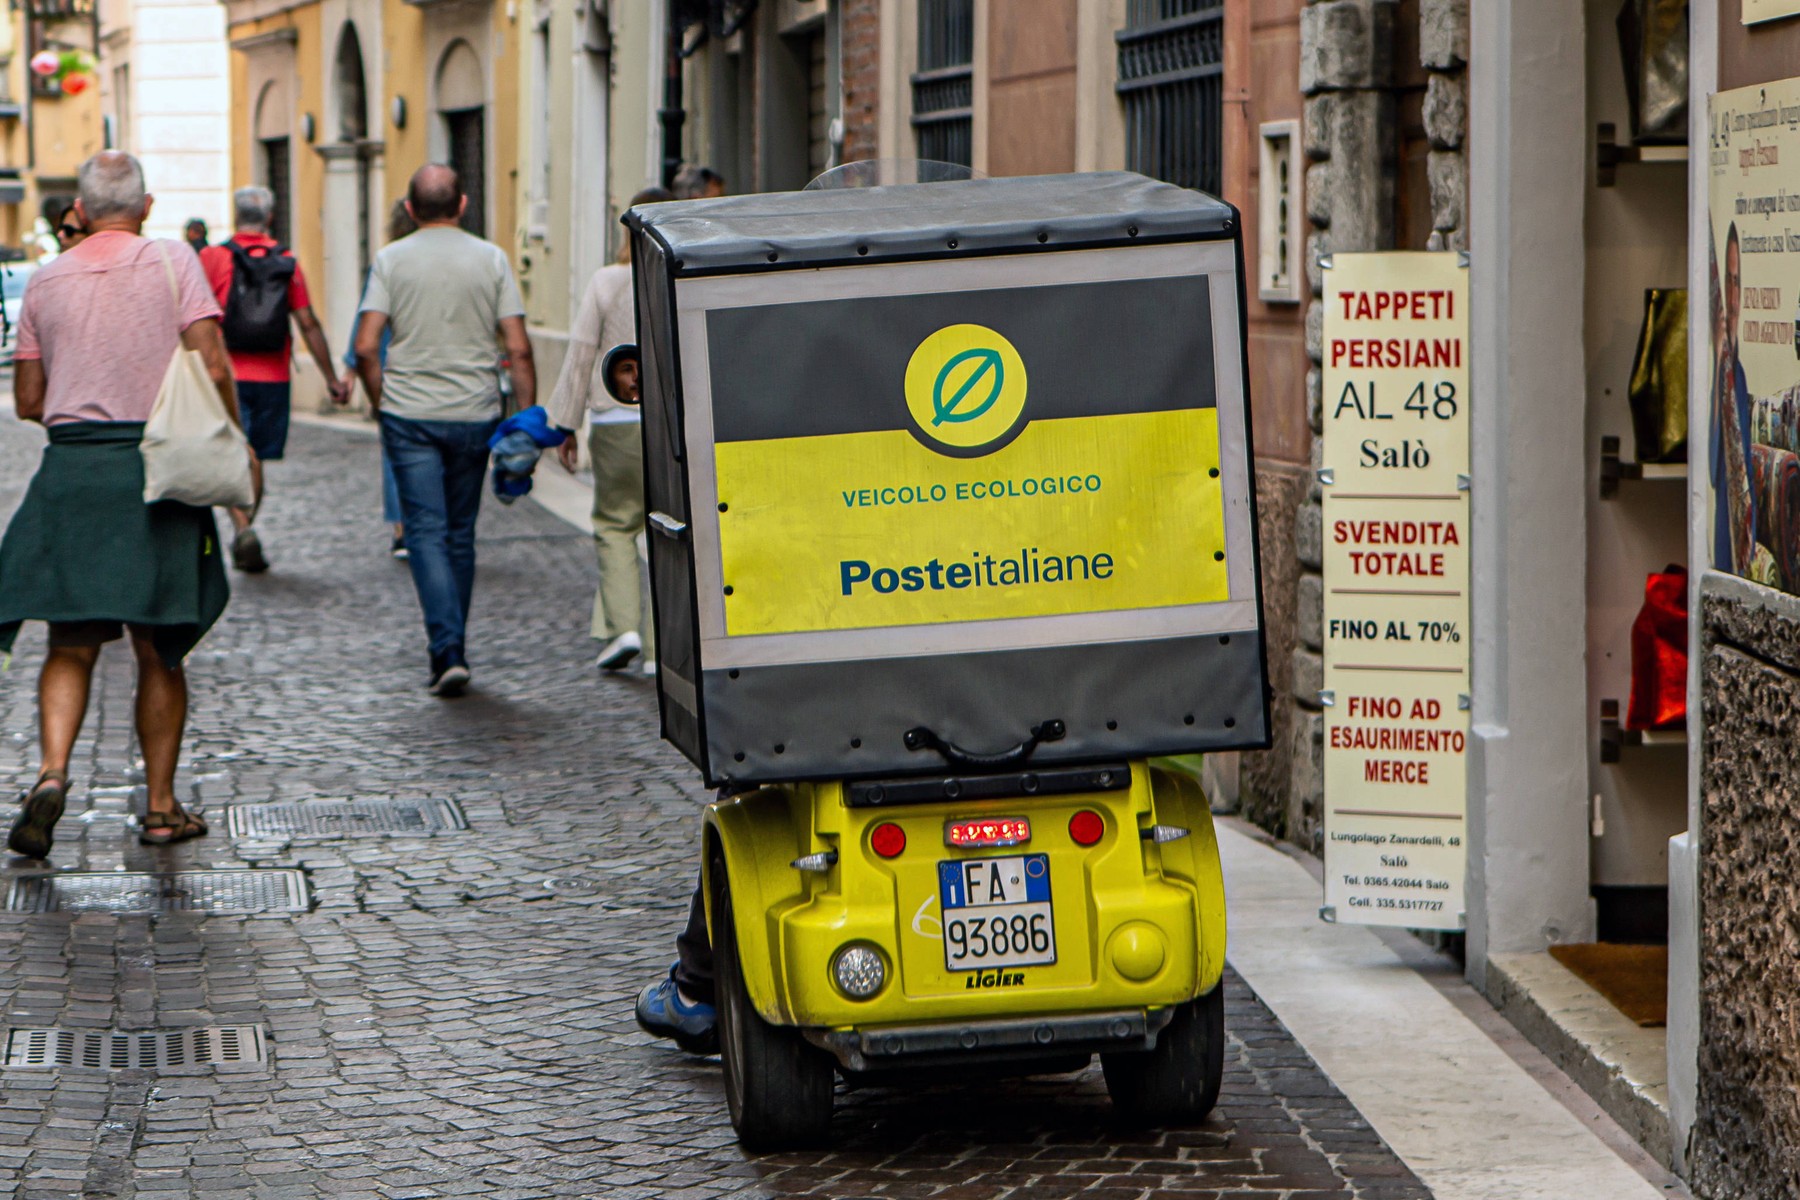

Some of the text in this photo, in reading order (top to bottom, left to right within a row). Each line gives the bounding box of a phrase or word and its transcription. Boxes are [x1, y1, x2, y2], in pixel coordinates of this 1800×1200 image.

[1338, 290, 1454, 320] TAPPETI
[1331, 338, 1461, 368] PERSIANI
[1334, 380, 1457, 420] AL 48
[1359, 438, 1430, 468] Salò
[842, 474, 1102, 508] VEICOLO ECOLOGICO
[1334, 520, 1459, 546] SVENDITA
[839, 547, 1114, 596] Posteitaliane
[1349, 551, 1444, 576] TOTALE
[1330, 619, 1460, 644] FINO AL 70%
[1347, 696, 1441, 720] FINO AD
[1330, 725, 1465, 753] ESAURIMENTO
[1364, 759, 1429, 785] MERCE
[1331, 831, 1461, 847] Lungolago Zanardelli, 48
[1379, 854, 1408, 868] Salò
[964, 861, 1006, 904] FA
[1343, 875, 1361, 886] Tel.
[1363, 876, 1423, 889] 0365.42044
[1348, 896, 1443, 912] Cell. 335.5317727
[948, 913, 1049, 960] 93886
[965, 968, 1025, 989] LIGIER
